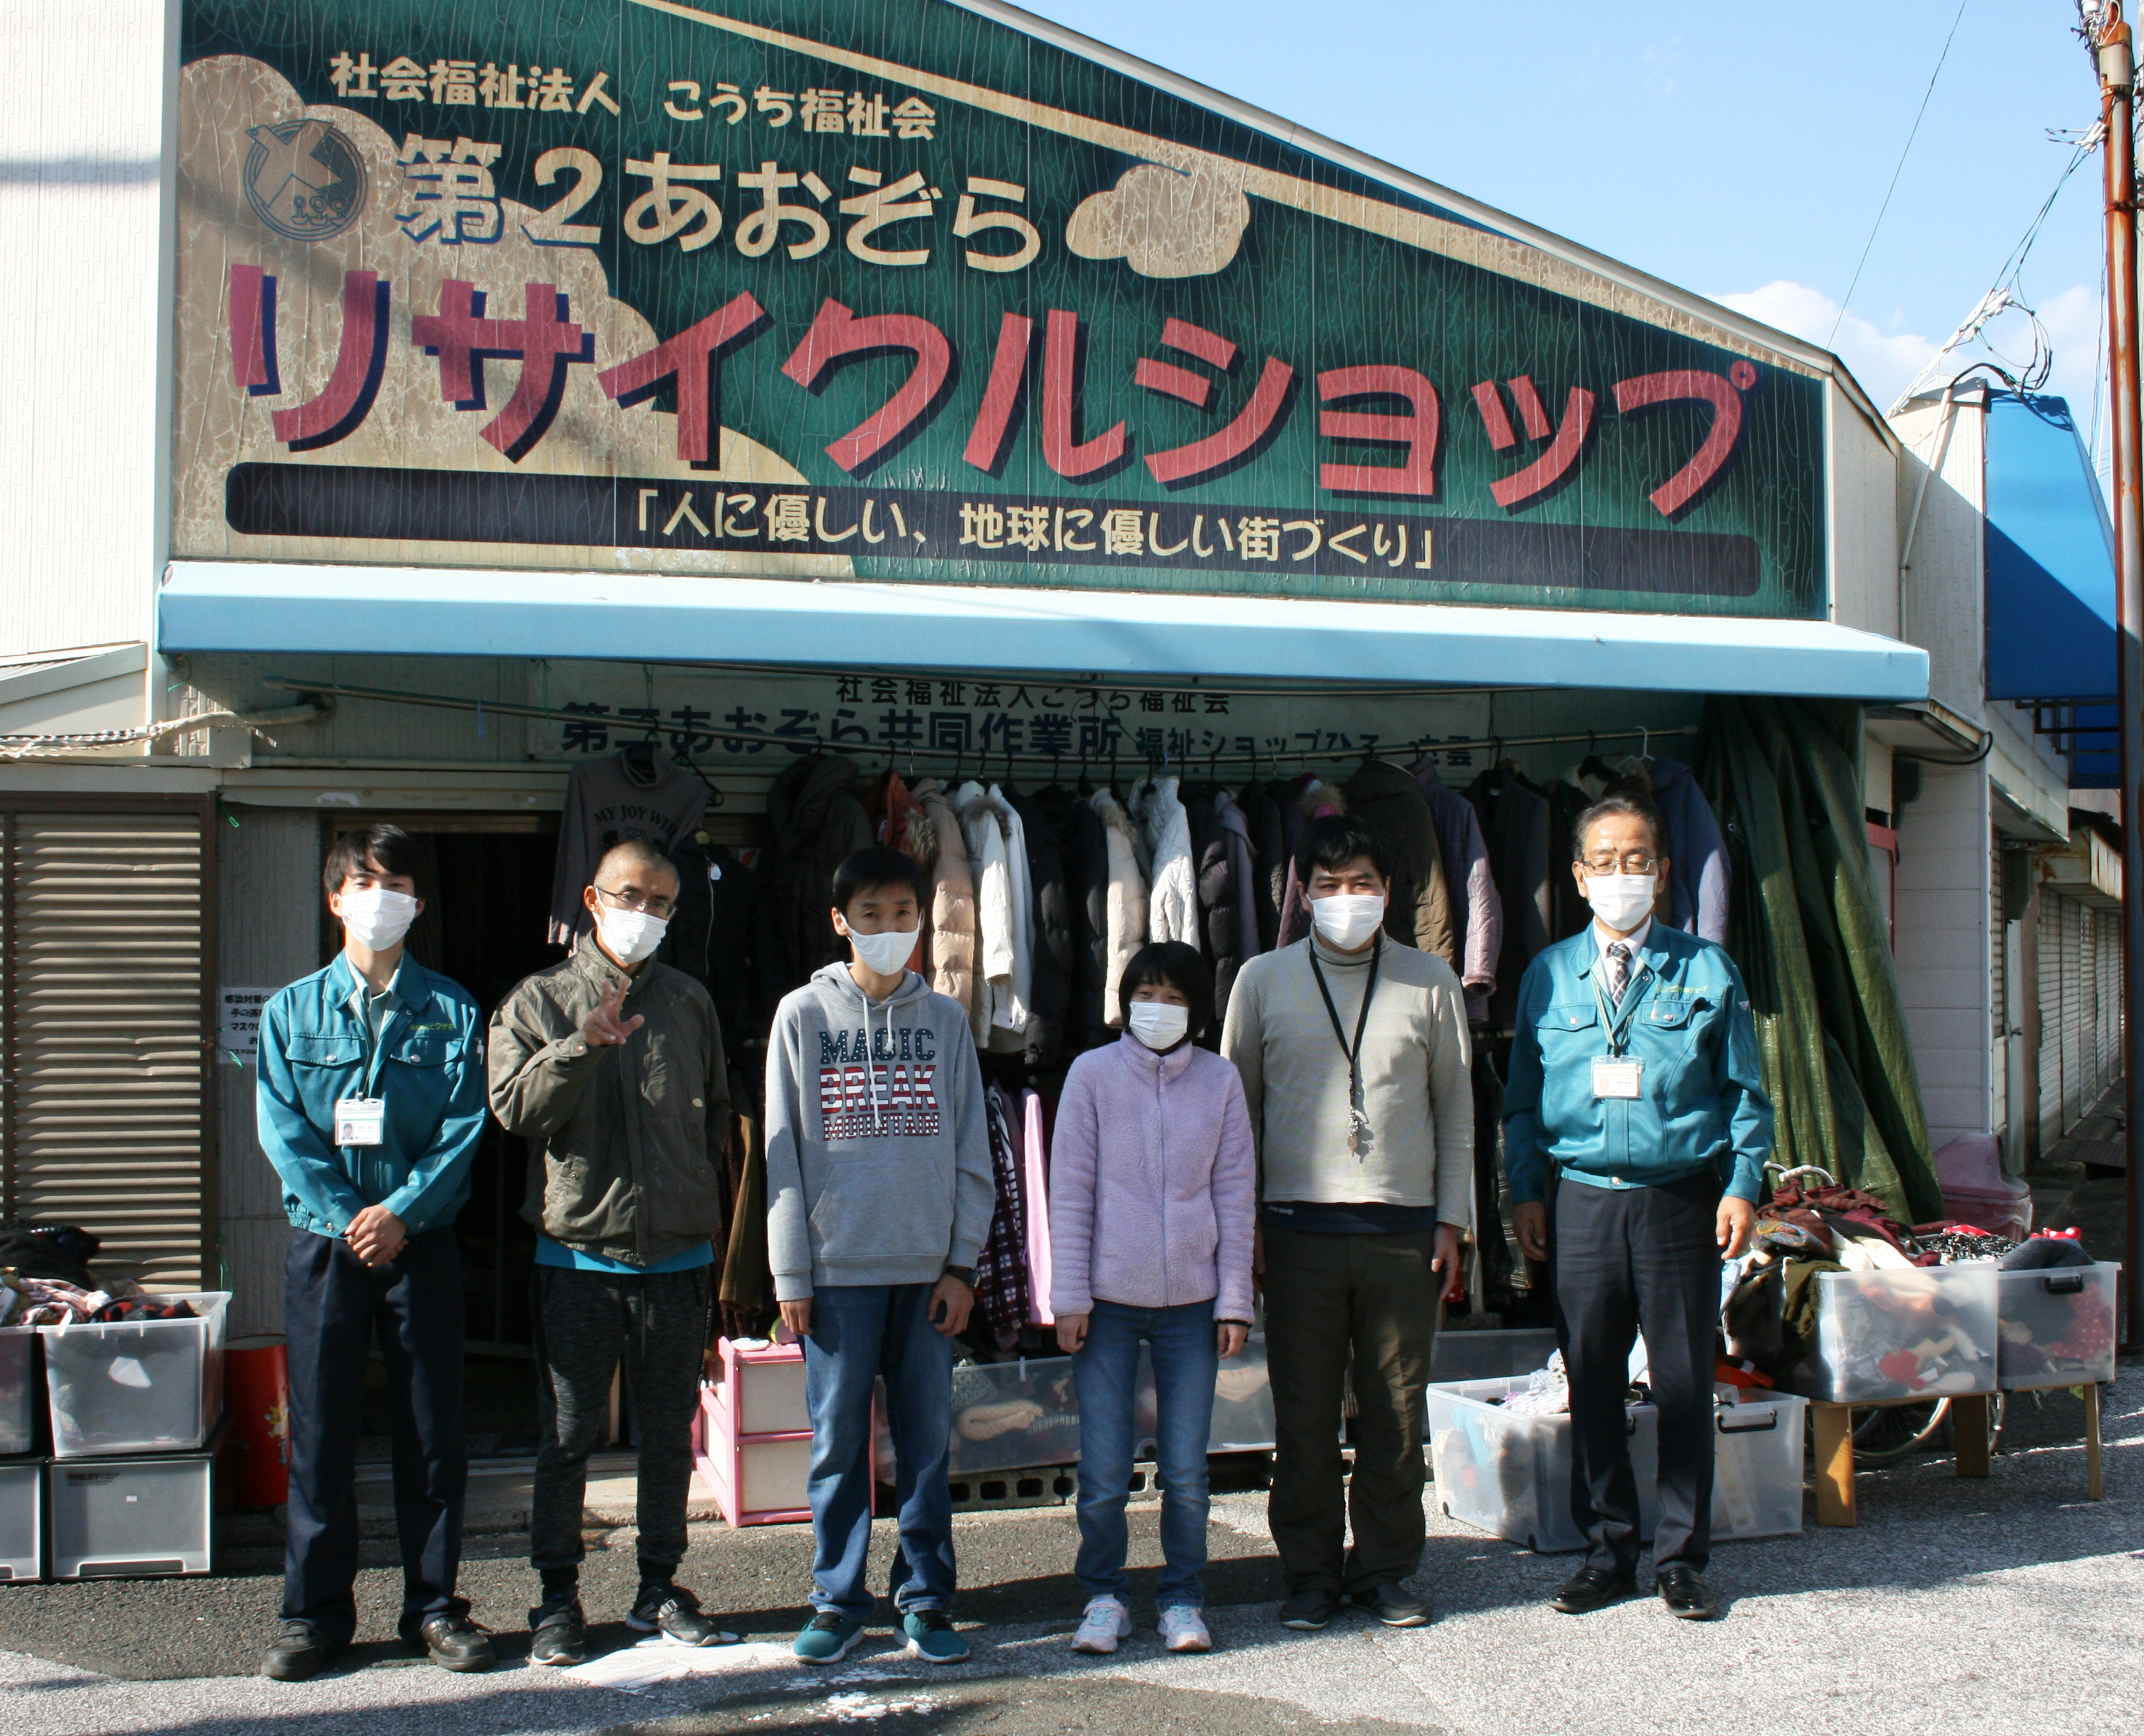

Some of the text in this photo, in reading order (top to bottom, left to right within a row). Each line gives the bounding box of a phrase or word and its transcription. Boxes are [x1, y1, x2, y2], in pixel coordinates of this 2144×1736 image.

[330, 51, 936, 141] 社会福祉法人 こうち福祉会
[395, 132, 1041, 273] 第2あおぞら
[230, 263, 1757, 522] リサイクルショップ
[593, 805, 616, 825] MY
[619, 804, 648, 821] JOY
[819, 1028, 935, 1064] MAGIC
[820, 1064, 938, 1114] BREAK
[823, 1112, 940, 1141] MOUNTAIN
